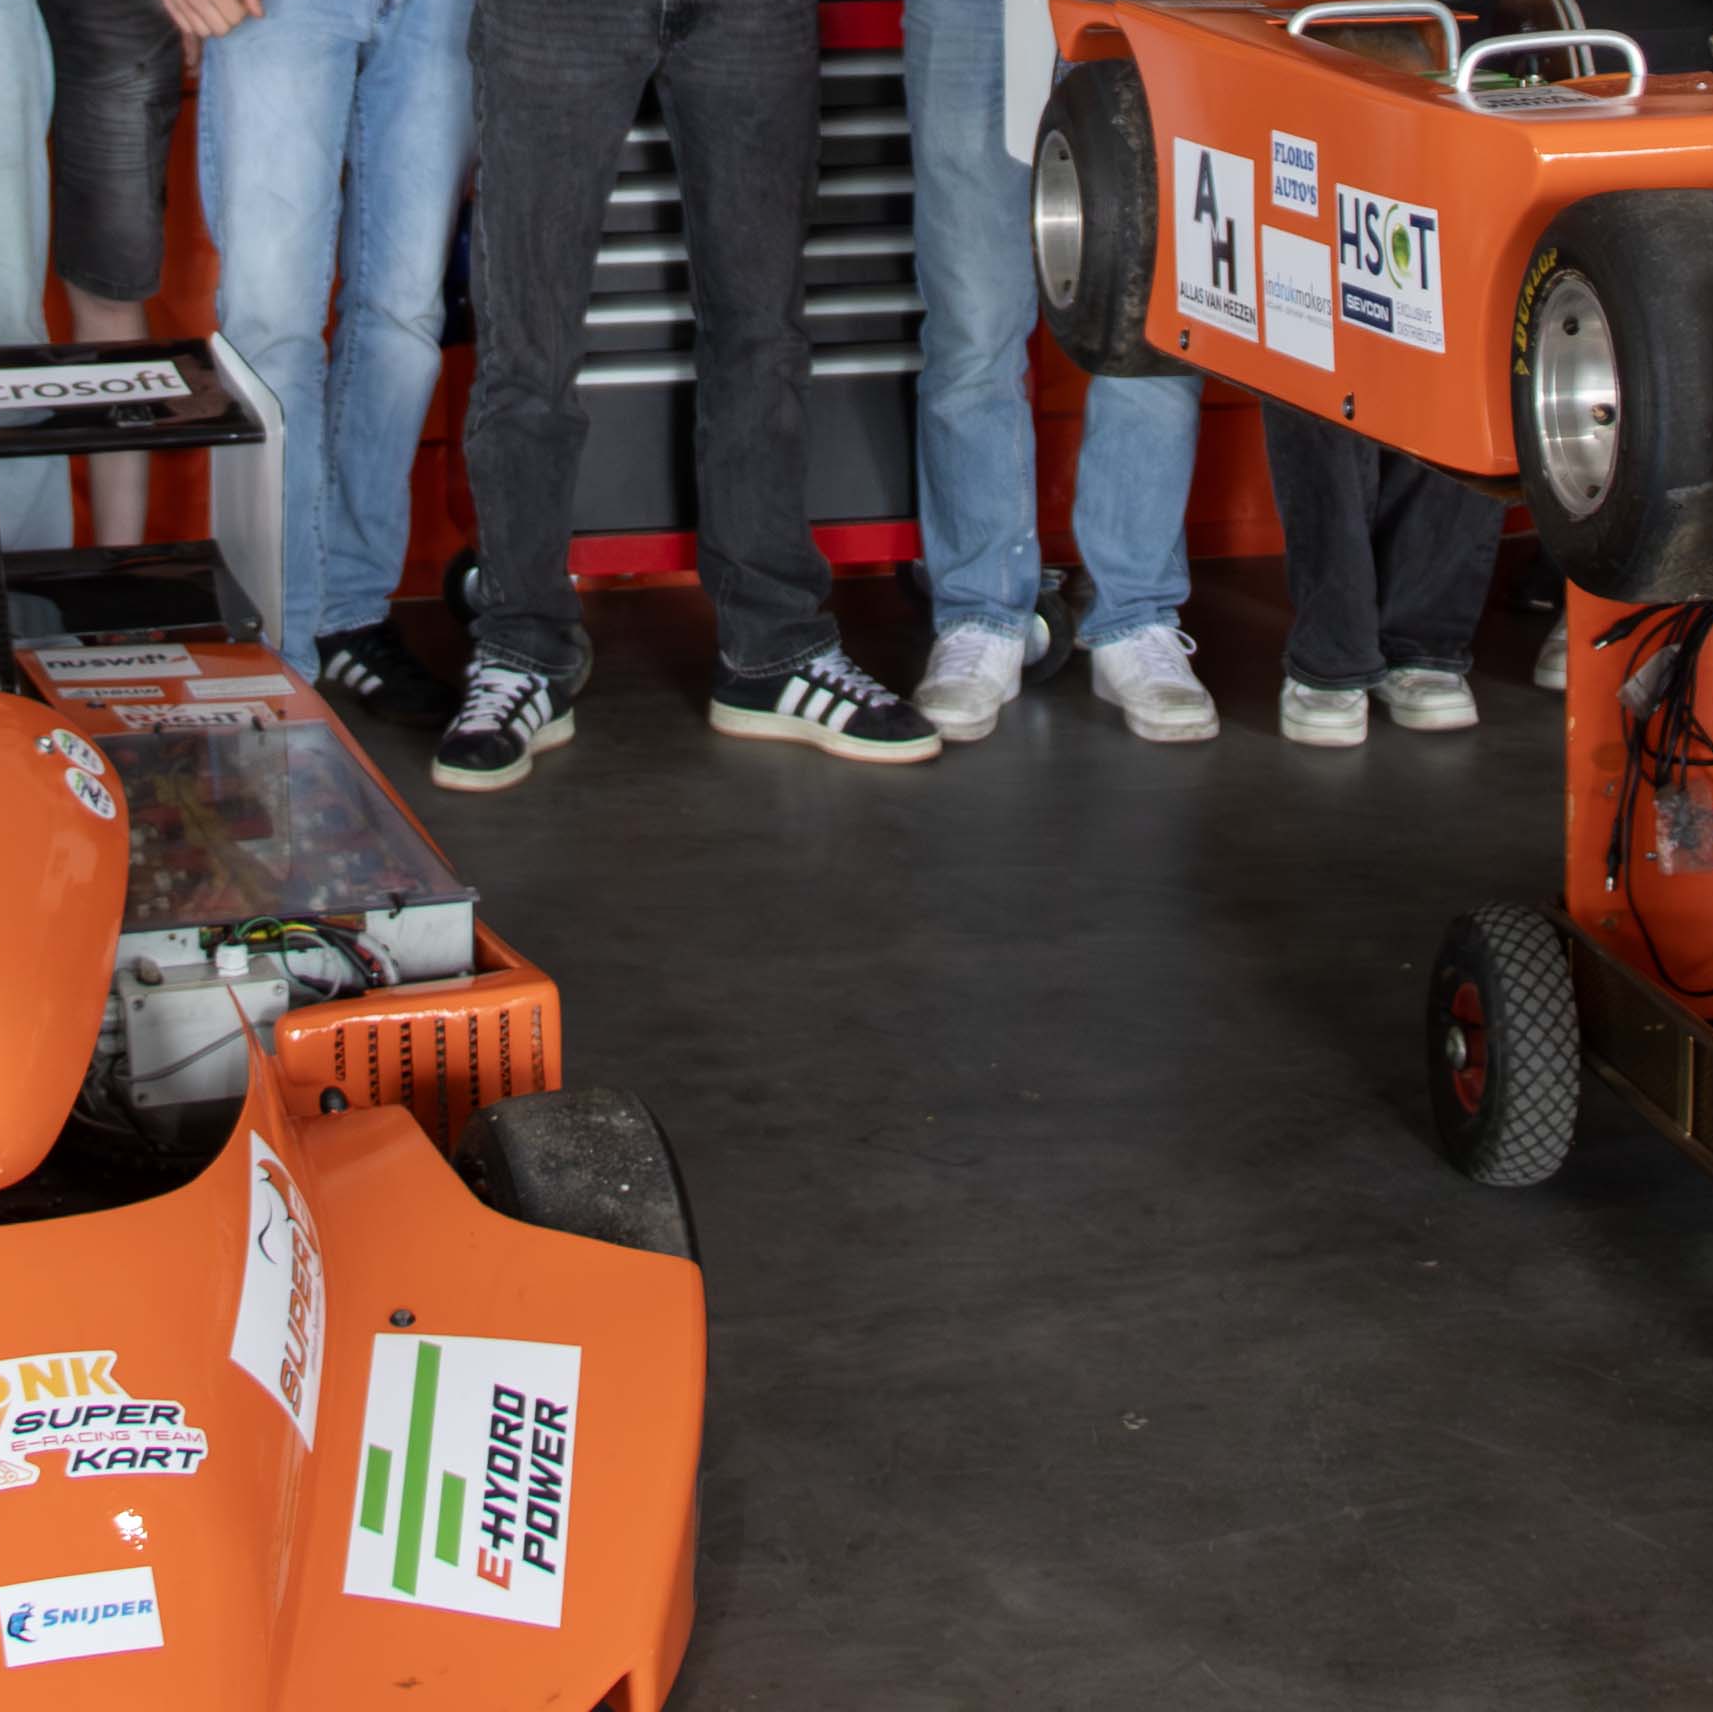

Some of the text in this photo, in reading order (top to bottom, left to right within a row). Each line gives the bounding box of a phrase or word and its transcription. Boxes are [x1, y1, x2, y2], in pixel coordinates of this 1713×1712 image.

[1273, 141, 1315, 171] FLORIS
[1273, 175, 1317, 206] AUTO'S
[1179, 280, 1204, 305] ALLAS
[1205, 288, 1223, 311] VAN
[1223, 296, 1257, 325] HEEZEN
[1265, 271, 1332, 316] indrukmakers
[1346, 294, 1390, 322] SEVCON
[1515, 247, 1557, 353] DUNLOP
[280, 1226, 312, 1418] SUPER
[11, 1404, 181, 1435] SUPER
[11, 1430, 203, 1452] E-RACING TEAM
[71, 1448, 203, 1472] KART
[522, 1397, 569, 1576] POWER
[43, 1599, 154, 1627] SNIJDER
